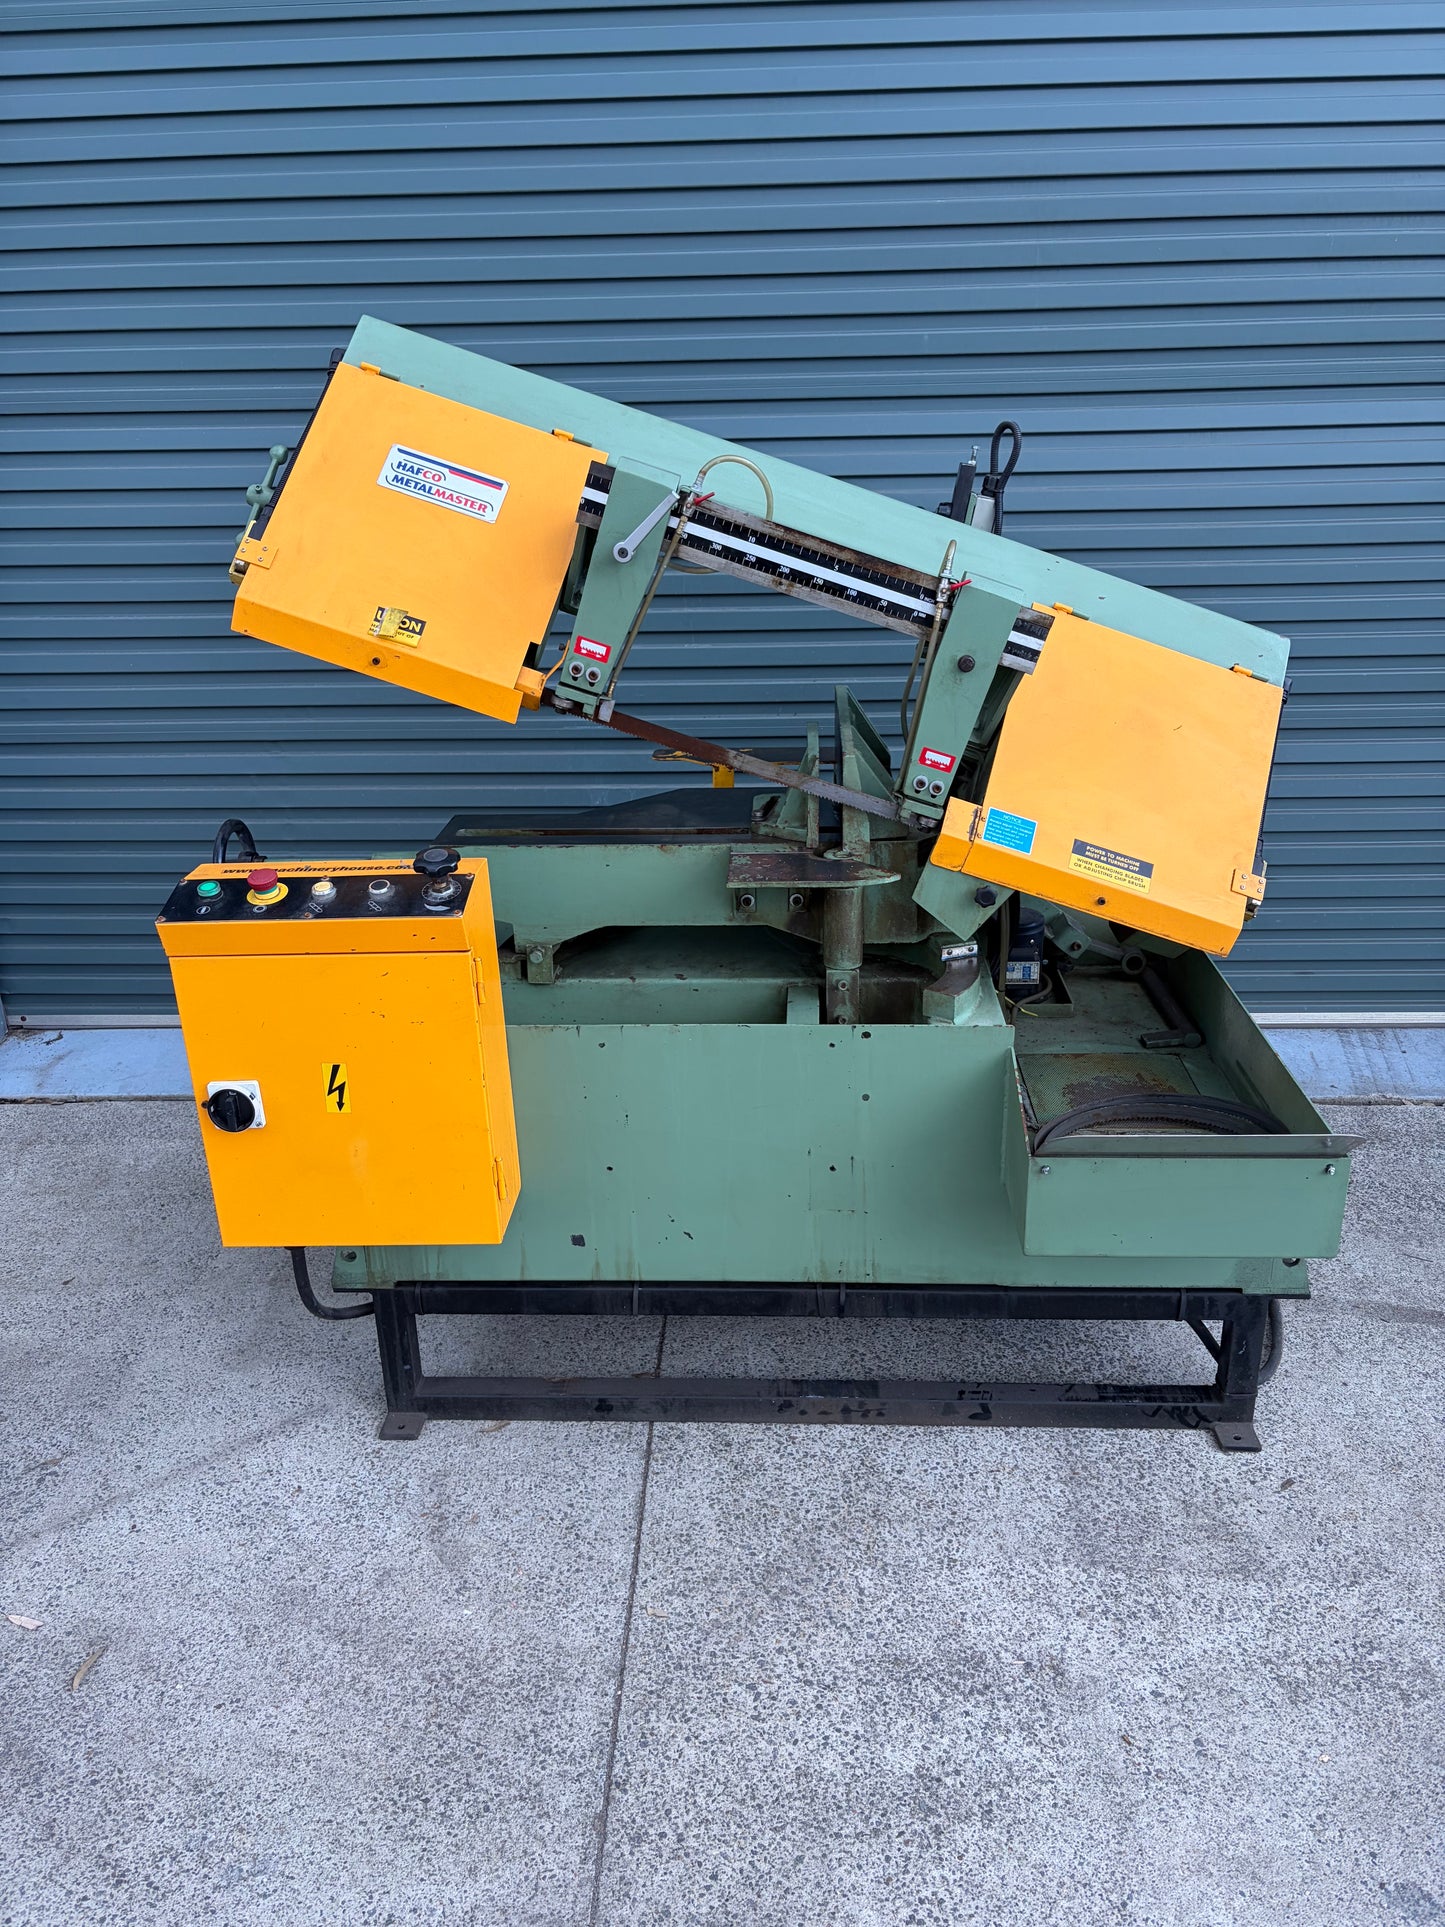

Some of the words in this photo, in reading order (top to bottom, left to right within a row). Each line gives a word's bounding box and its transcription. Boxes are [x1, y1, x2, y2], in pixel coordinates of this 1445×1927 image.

[397, 461, 442, 482] HAFCO
[392, 475, 488, 513] METALMASTER
[711, 543, 722, 551] 300
[745, 554, 756, 563] 250
[779, 566, 789, 574] 200
[813, 577, 823, 585] 150
[847, 588, 857, 596] 100
[1003, 814, 1021, 823] NOTICE
[1085, 851, 1099, 859] MUST
[1108, 858, 1128, 868] TURNED
[1087, 846, 1106, 855] POWER
[1117, 856, 1140, 866] MACHINE
[1077, 857, 1092, 866] WHEN
[1095, 864, 1123, 876] CHANGING
[1125, 874, 1144, 882] BLADES
[1083, 866, 1113, 878] ADJUSTING
[1127, 880, 1145, 888] BRUSH
